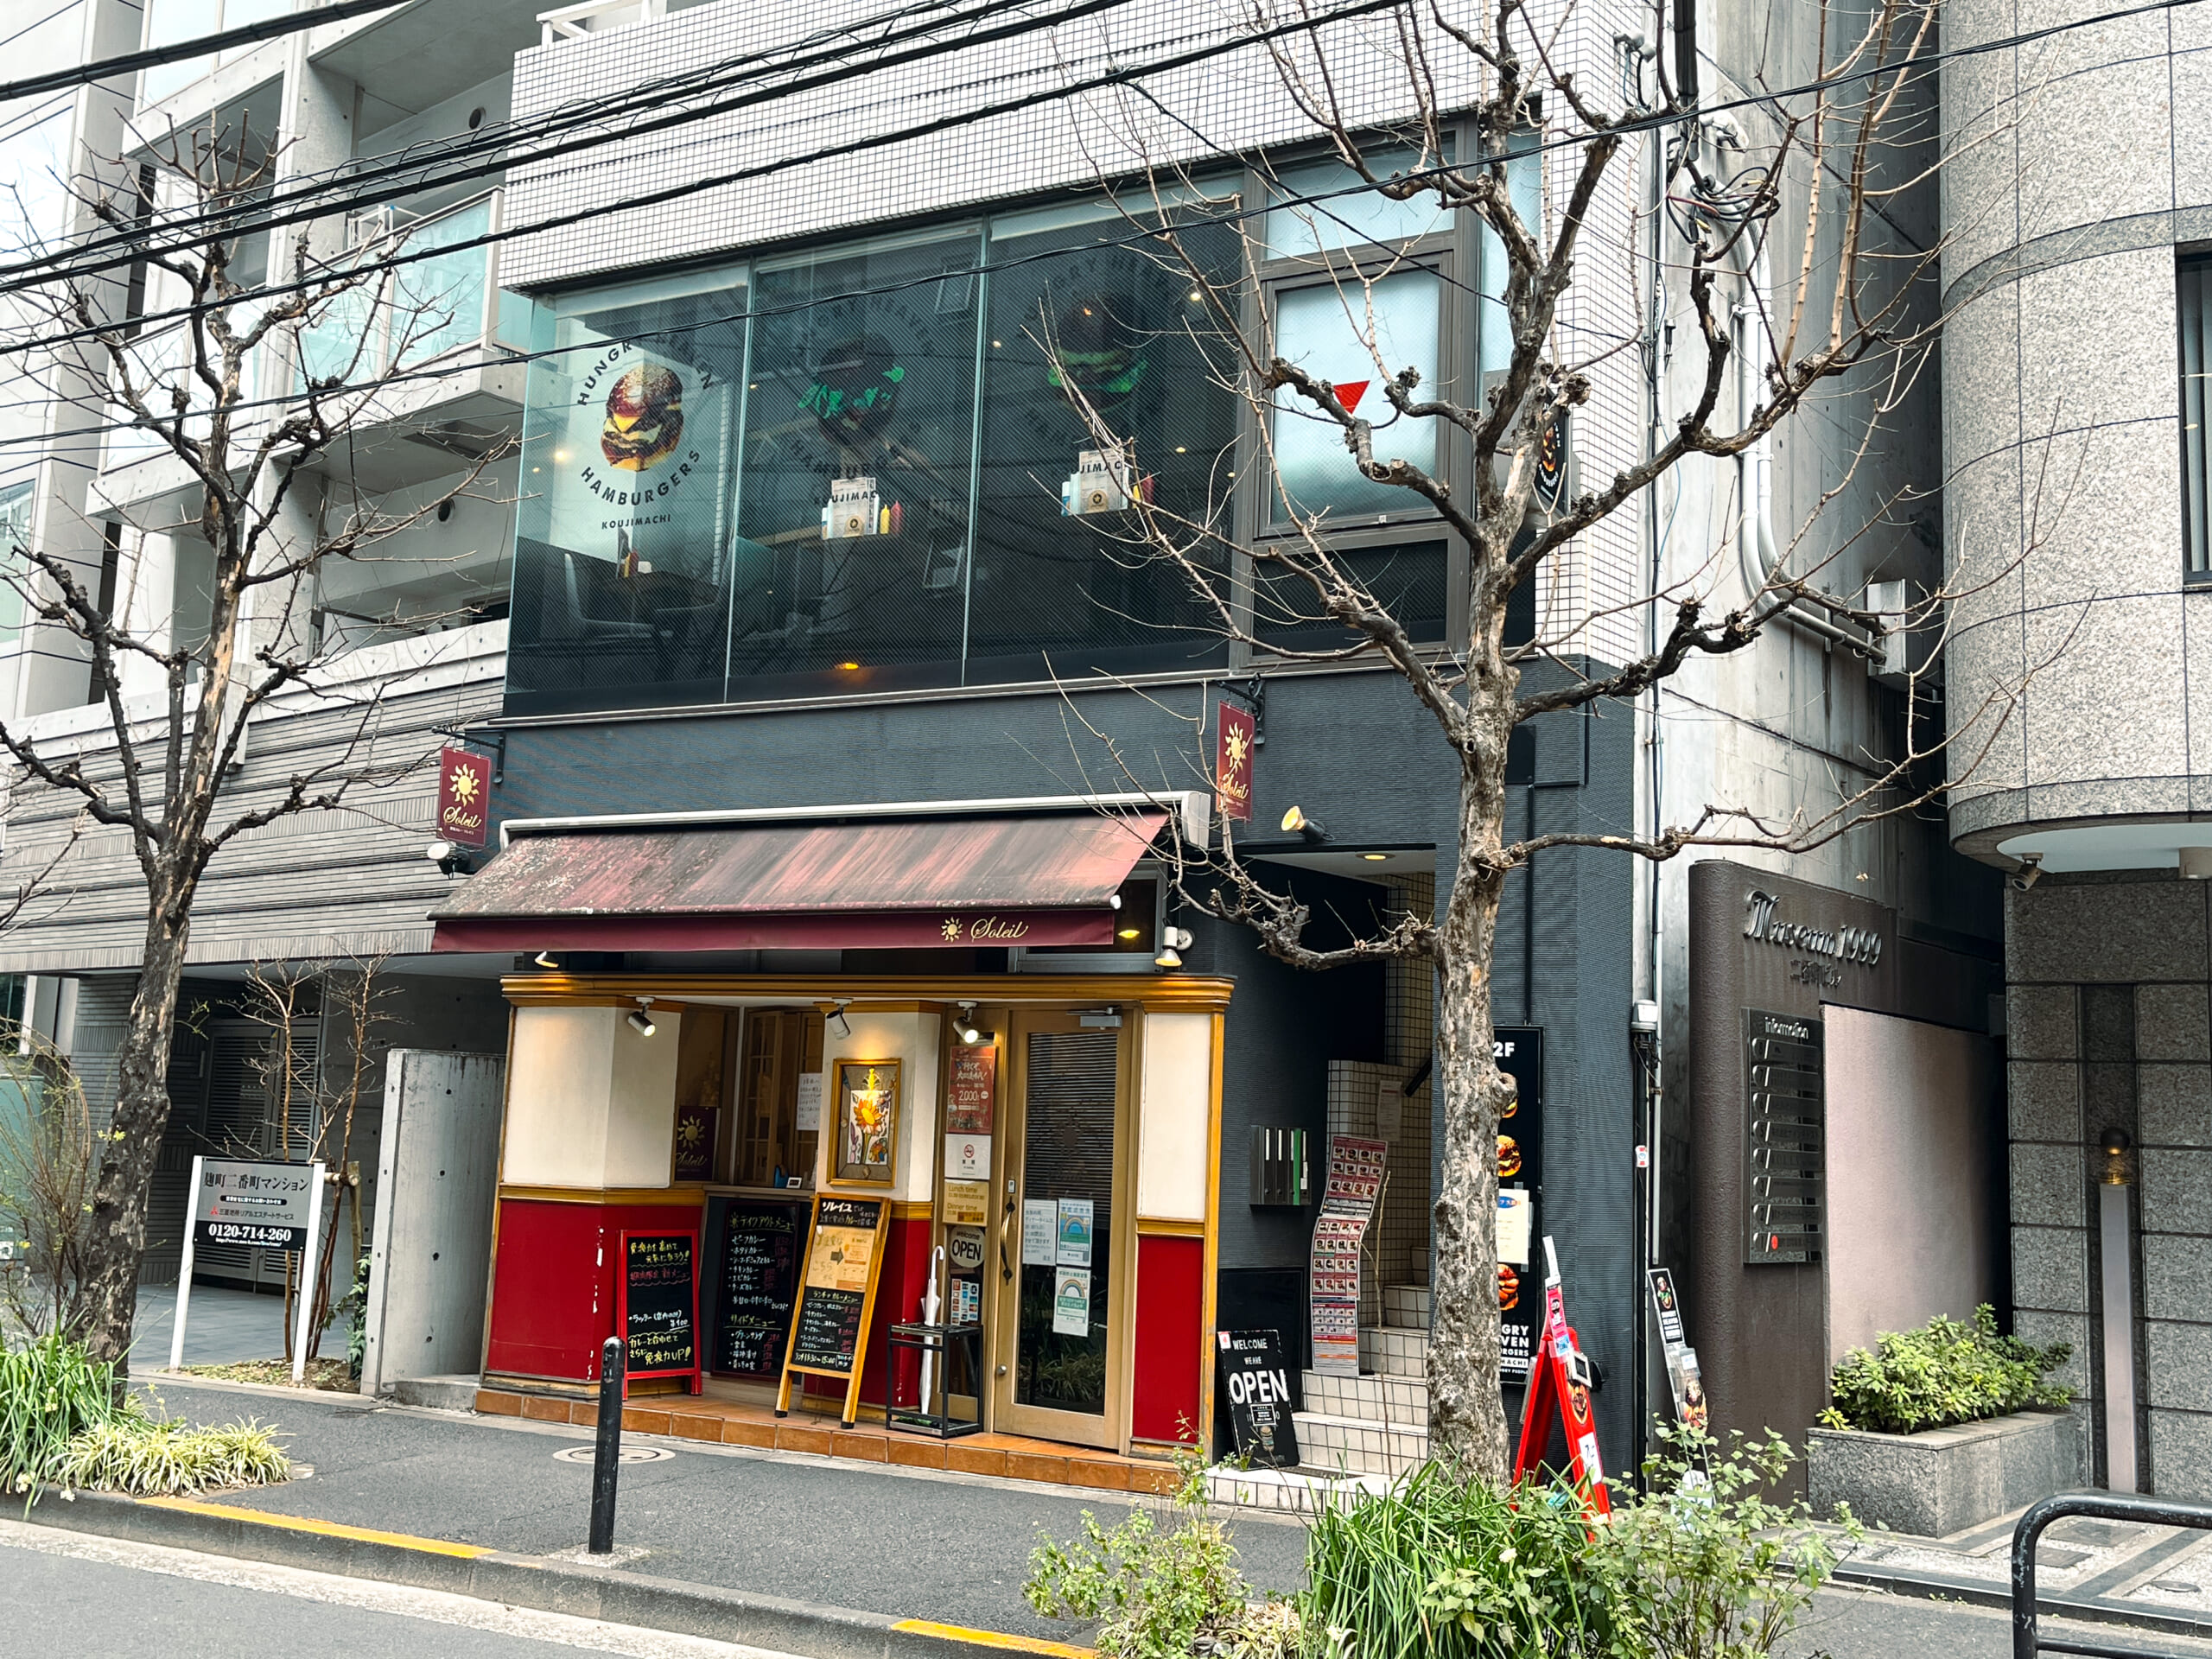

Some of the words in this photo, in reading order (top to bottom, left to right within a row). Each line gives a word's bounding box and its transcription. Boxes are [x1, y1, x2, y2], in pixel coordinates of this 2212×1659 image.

[577, 337, 641, 406] HUNGR
[581, 450, 700, 506] HAMBURGERS
[601, 514, 671, 530] KOUJIMACHI
[443, 806, 482, 829] Soleil
[970, 916, 1029, 943] Soleil
[1743, 890, 1835, 956] Museum
[1835, 924, 1882, 966] 1999
[1493, 1041, 1515, 1058] 2F
[208, 1224, 292, 1242] 0120-714-260
[957, 1230, 981, 1241] welcome
[951, 1239, 982, 1262] OPEN
[1501, 1324, 1529, 1336] GRY
[1232, 1338, 1268, 1351] WELCOME
[1501, 1336, 1529, 1348] VEN
[1502, 1348, 1529, 1357] RGERS
[1229, 1369, 1290, 1405] OPEN
